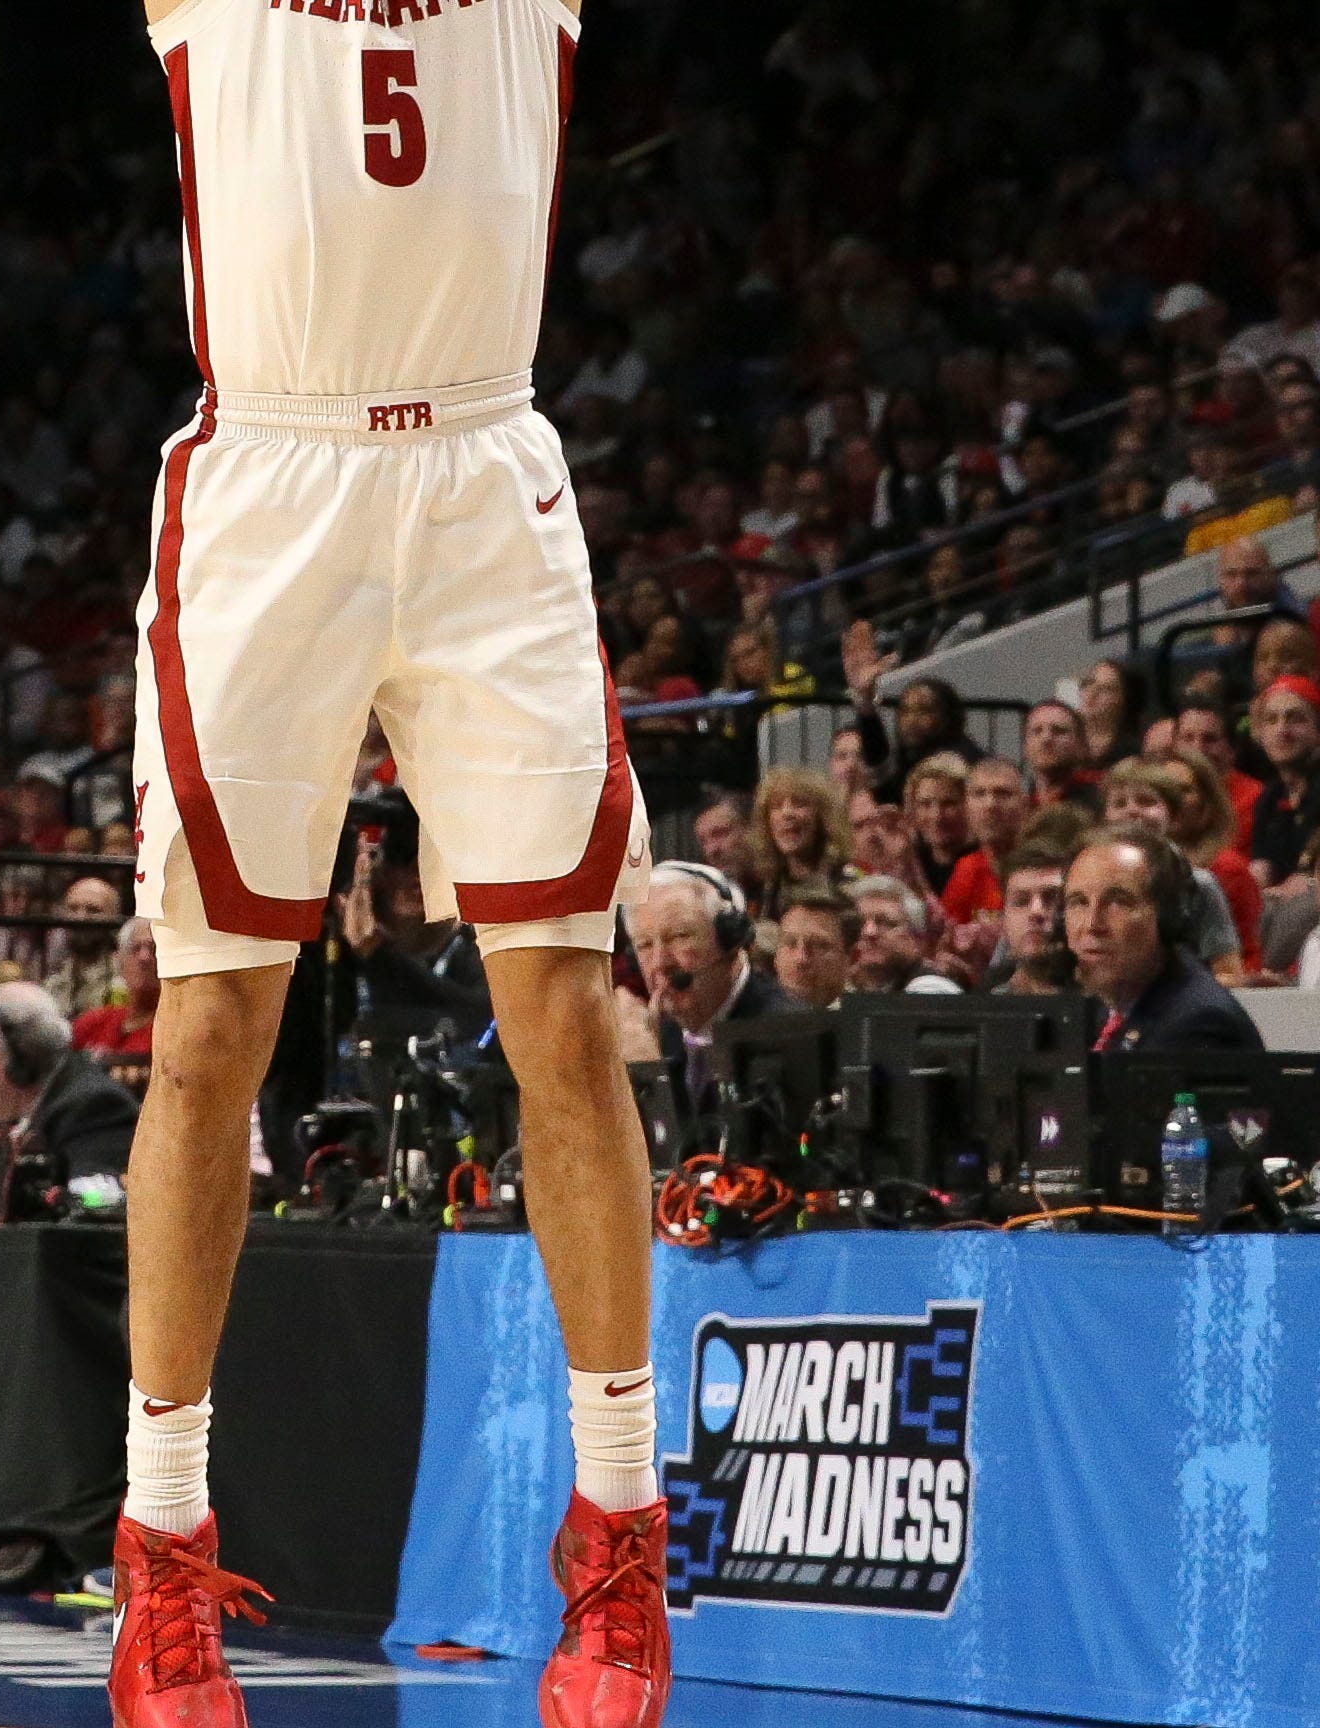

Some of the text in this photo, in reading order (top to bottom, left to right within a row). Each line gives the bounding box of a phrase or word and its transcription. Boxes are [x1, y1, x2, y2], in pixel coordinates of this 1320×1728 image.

[361, 49, 427, 187] 5
[367, 401, 433, 432] RTR
[732, 1340, 895, 1445] MARCH
[731, 1452, 969, 1565] MADNESS
